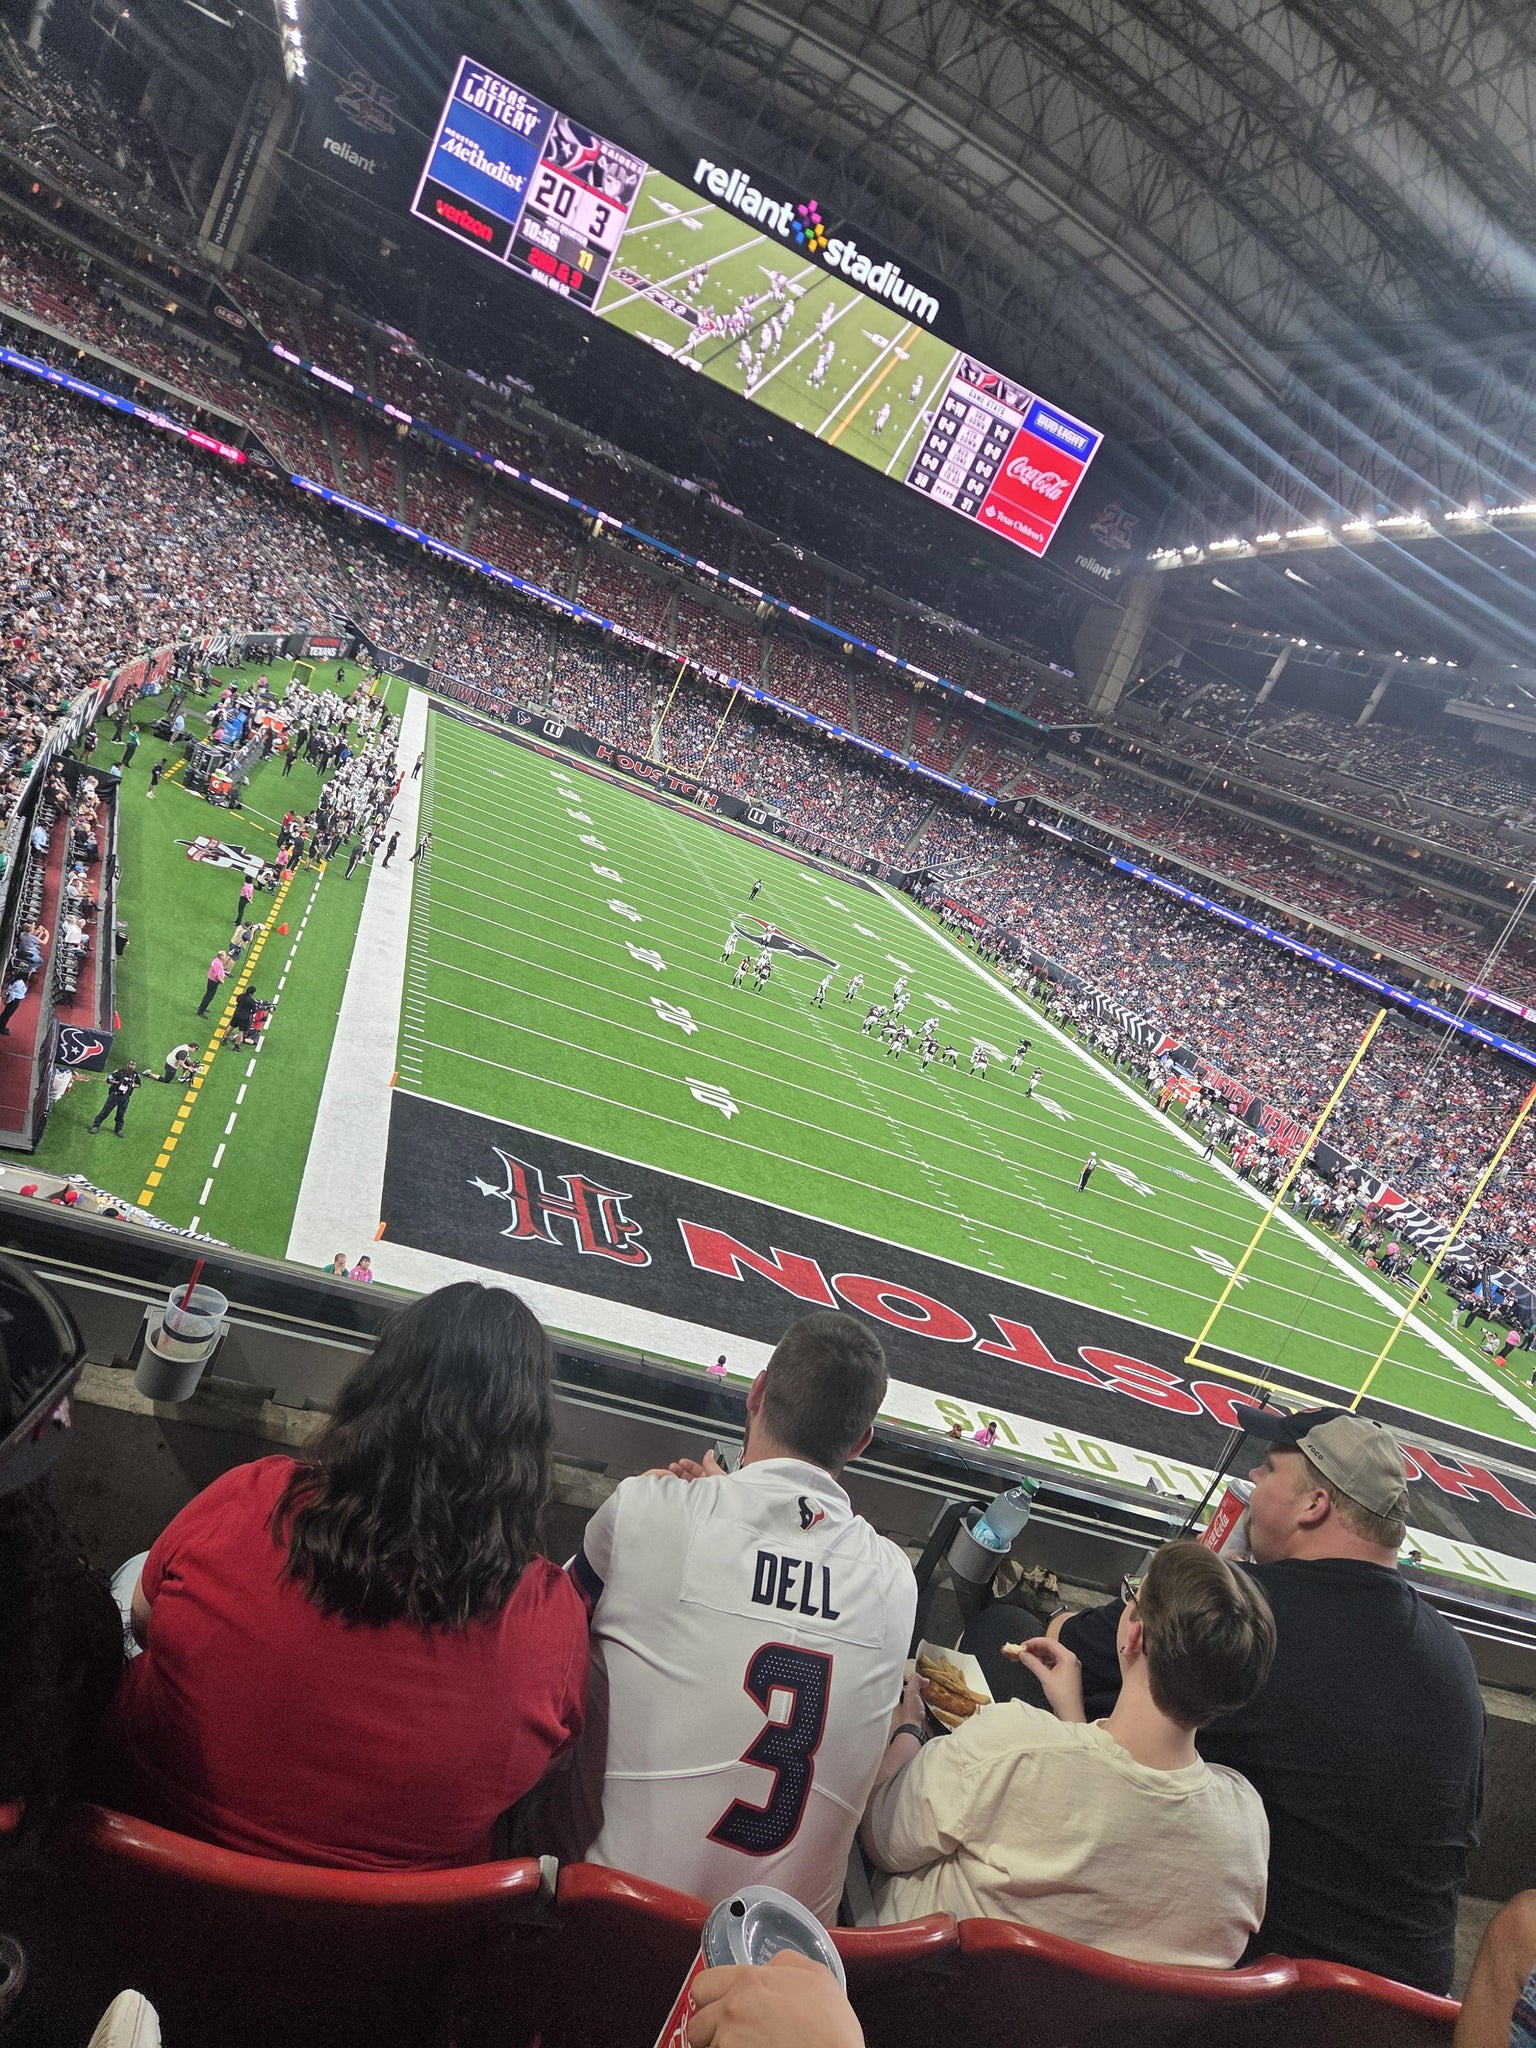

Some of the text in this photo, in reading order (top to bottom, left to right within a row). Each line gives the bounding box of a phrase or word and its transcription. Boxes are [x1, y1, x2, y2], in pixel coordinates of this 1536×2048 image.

[462, 79, 537, 136] LOTTERY
[483, 74, 527, 111] TEXAS
[323, 136, 376, 174] reliant
[440, 139, 523, 192] Methodist
[535, 173, 576, 219] 20
[436, 199, 493, 243] verizon
[589, 205, 610, 238] 3
[693, 158, 940, 324] reliant stadium
[578, 249, 593, 271] 11
[996, 510, 1016, 527] Texas
[1075, 552, 1112, 581] reliant
[443, 678, 479, 705] TOWN
[650, 996, 699, 1036] 20
[685, 1076, 740, 1118] 10
[1043, 1437, 1118, 1473] OF
[751, 1550, 840, 1621] DELL
[705, 1641, 834, 1857] 3
